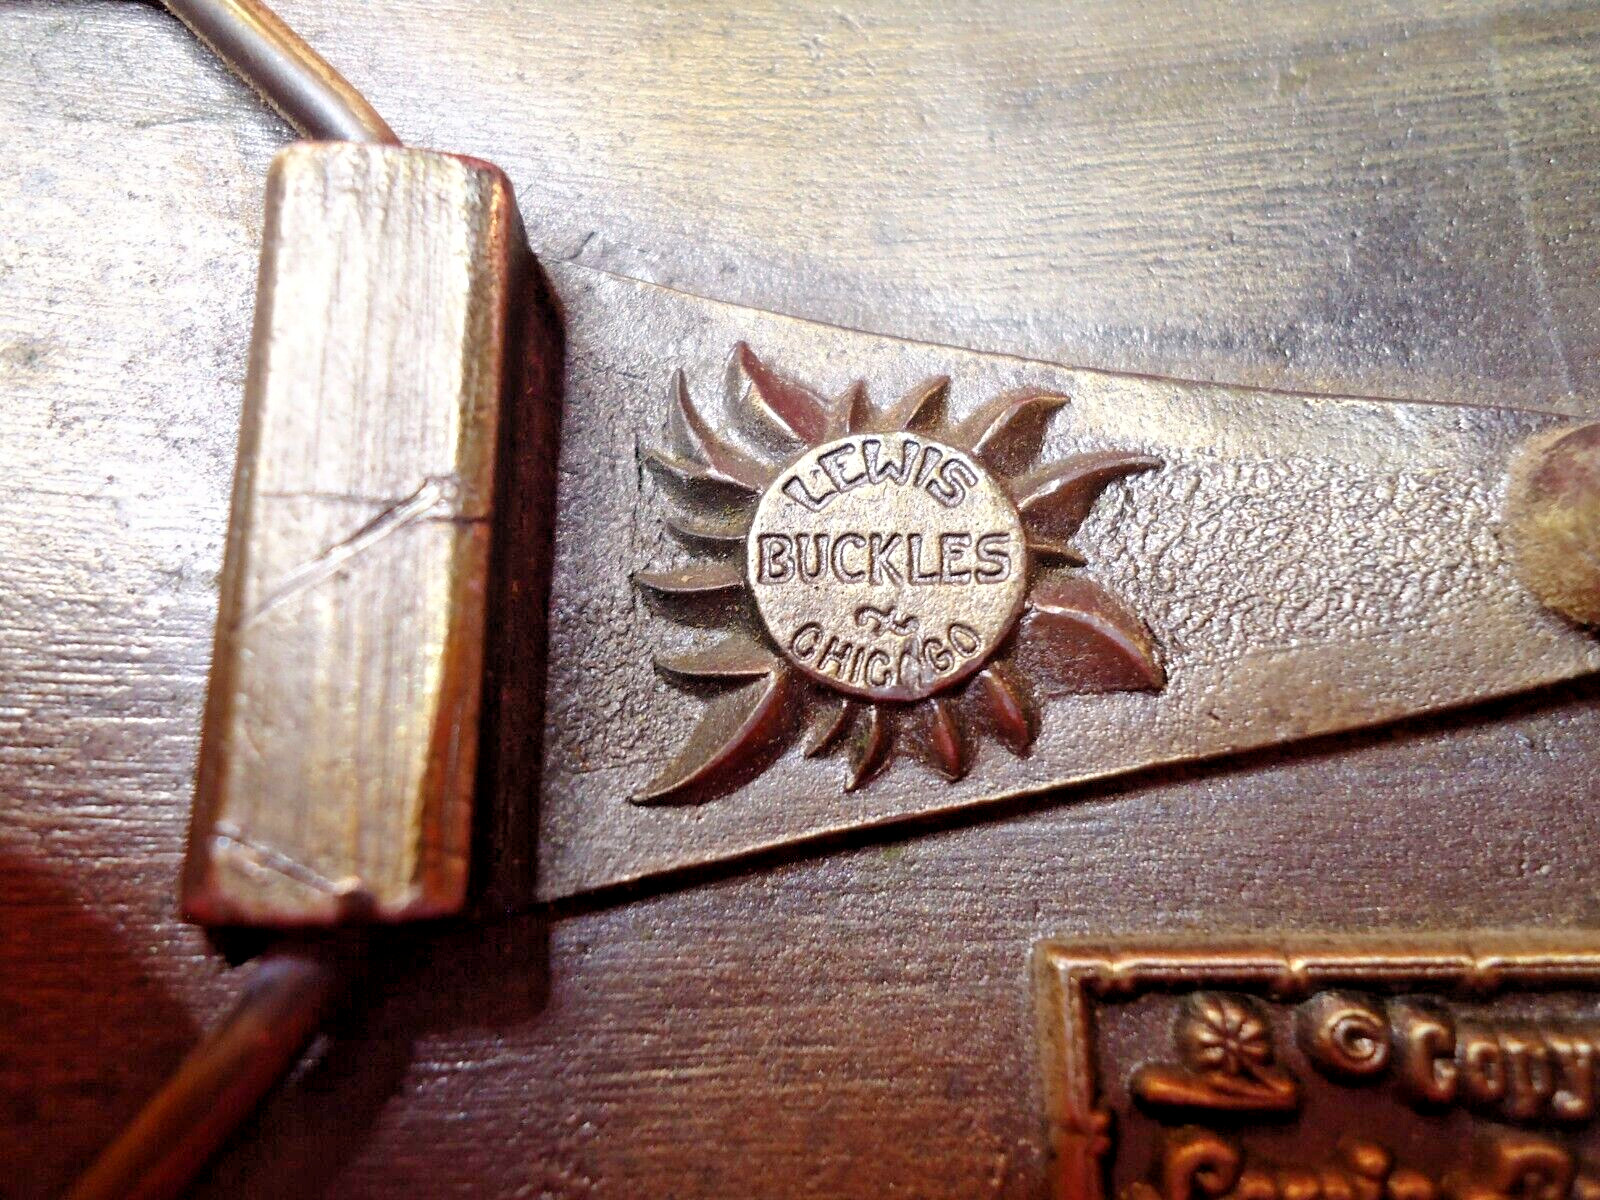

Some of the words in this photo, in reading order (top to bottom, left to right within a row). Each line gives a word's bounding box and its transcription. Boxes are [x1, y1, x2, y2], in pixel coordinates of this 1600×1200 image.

[782, 439, 979, 512] LEWIS
[756, 532, 1013, 586] BUCKLES
[790, 621, 983, 688] CHICAGO
